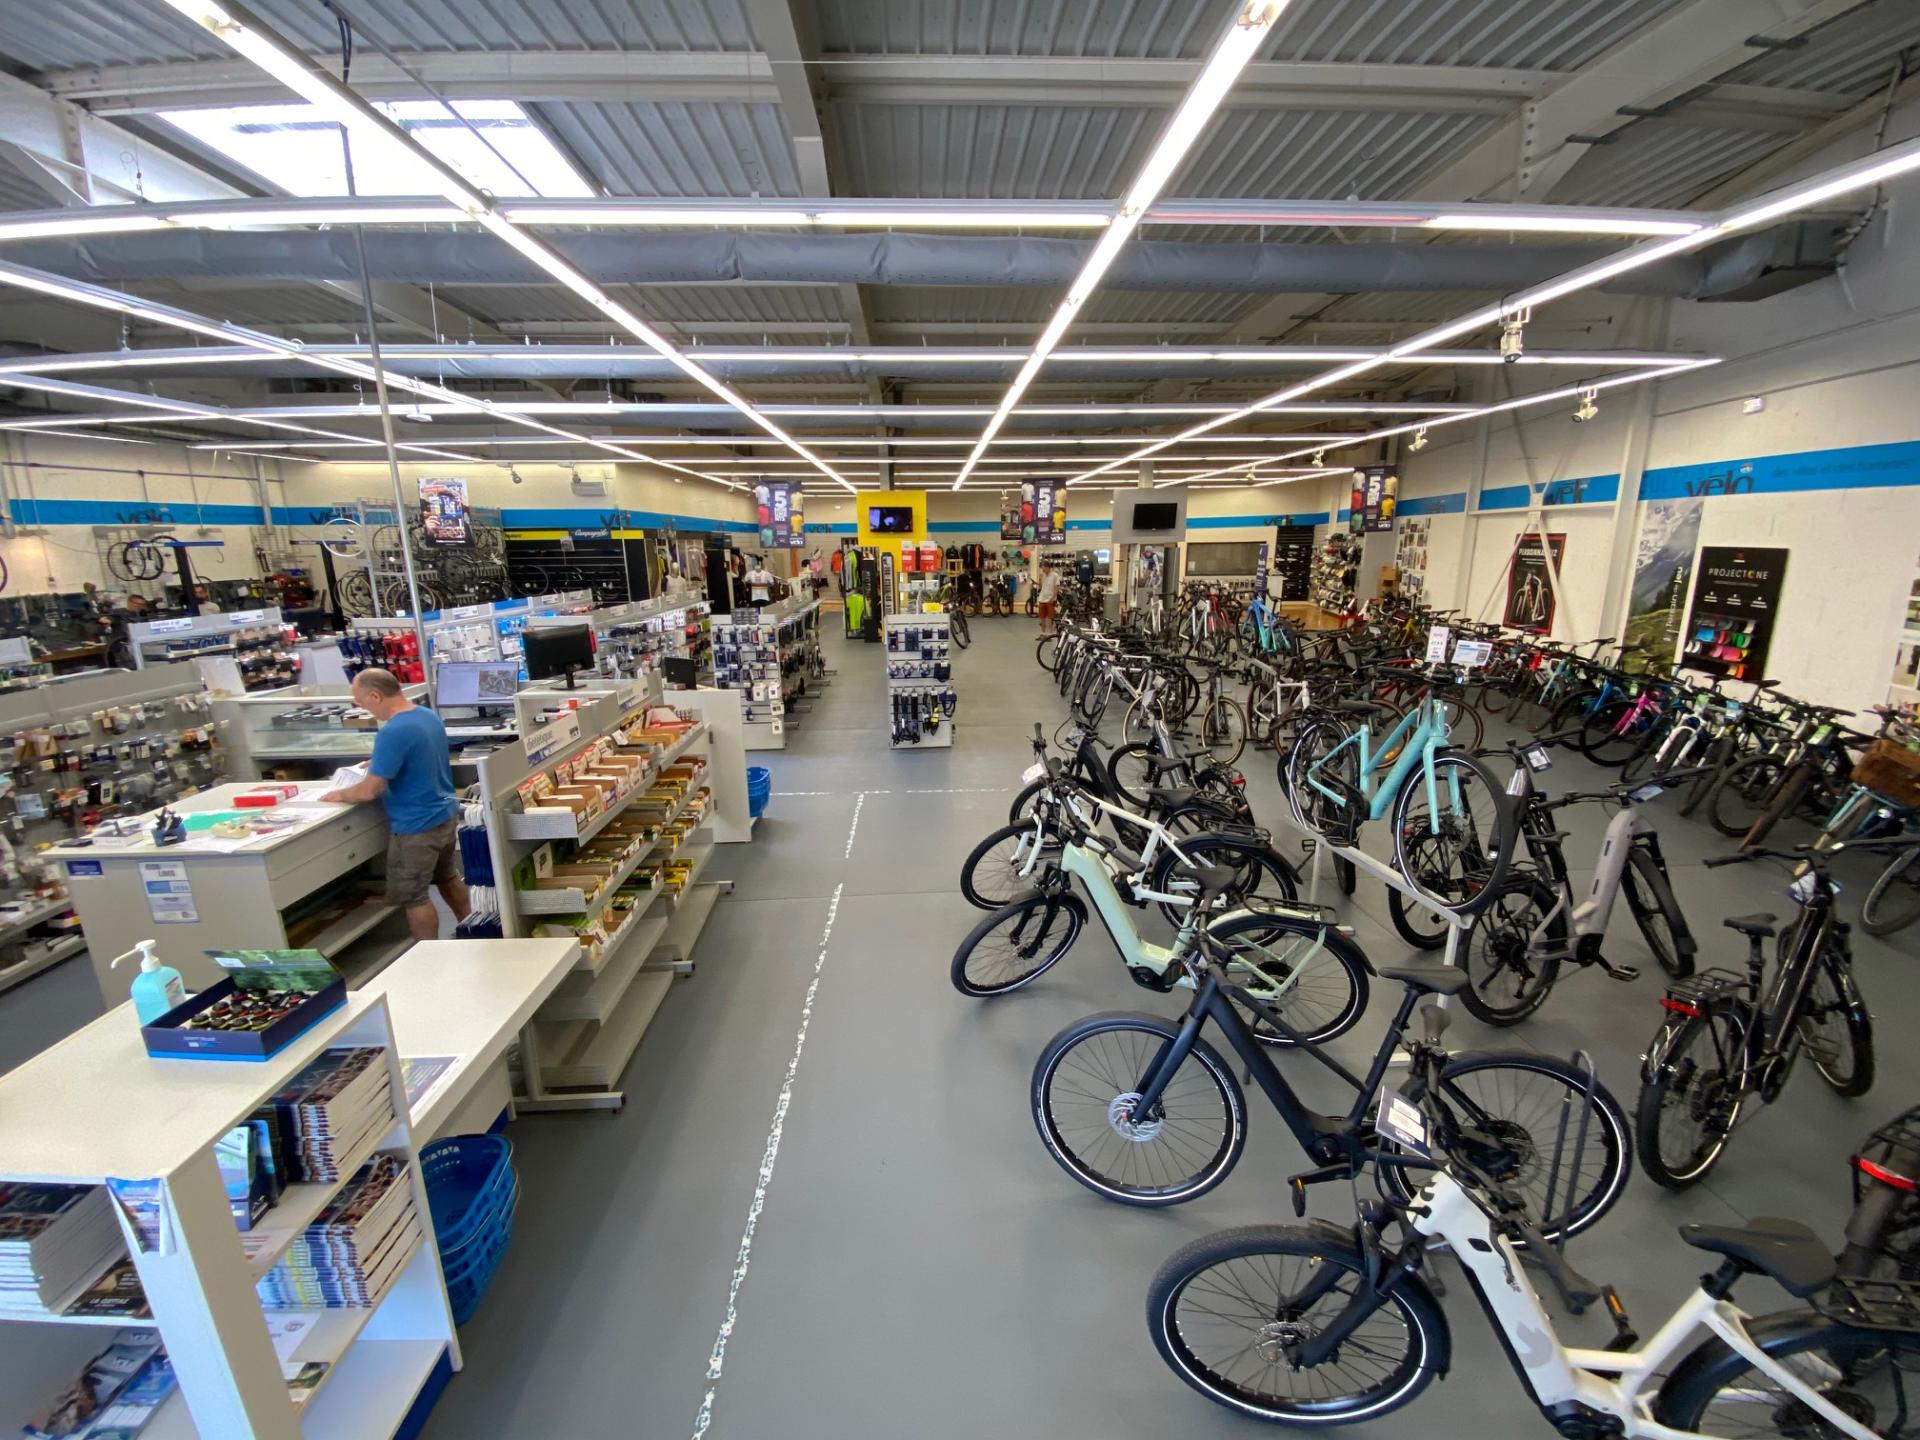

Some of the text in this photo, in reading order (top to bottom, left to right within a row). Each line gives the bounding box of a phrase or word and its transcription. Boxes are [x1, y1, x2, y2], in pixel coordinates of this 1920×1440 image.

[1369, 475, 1382, 493] 5
[774, 490, 788, 508] 5
[1038, 486, 1051, 506] 5
